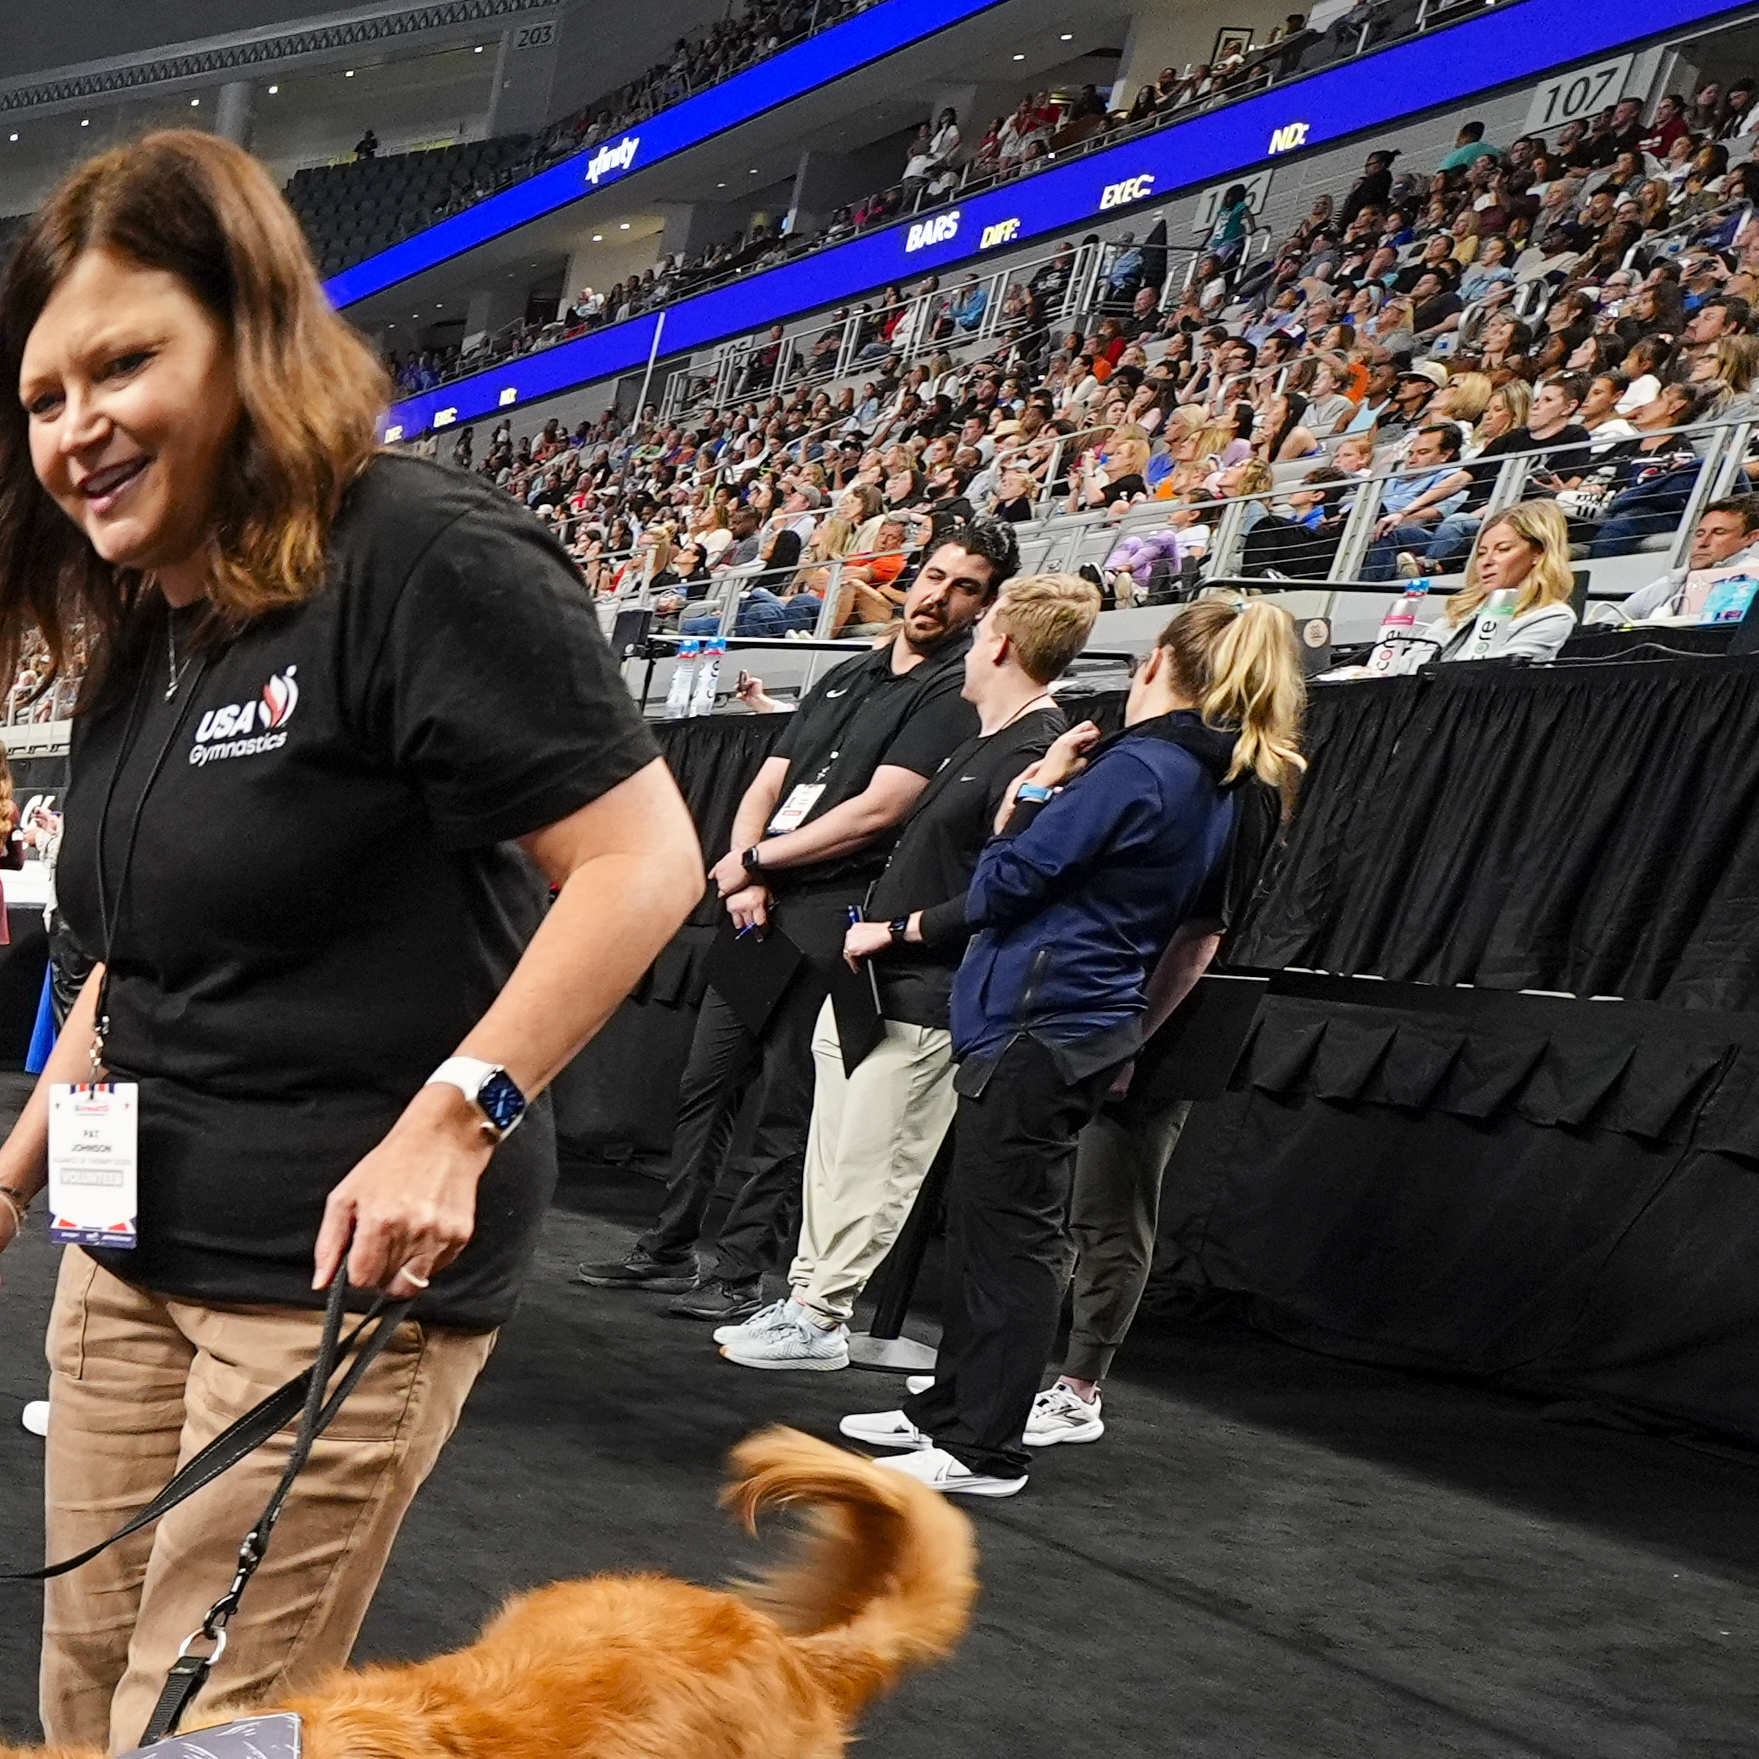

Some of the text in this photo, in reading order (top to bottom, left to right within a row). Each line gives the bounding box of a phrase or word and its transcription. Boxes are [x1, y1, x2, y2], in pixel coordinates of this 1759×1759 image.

[517, 26, 552, 48] 203
[1543, 67, 1619, 123] 107
[1269, 122, 1310, 155] ND:
[585, 137, 640, 184] xfinity
[1099, 174, 1155, 210] EXEC:
[1205, 177, 1262, 224] 16
[905, 210, 960, 253] BARS
[980, 217, 1021, 249] DIFF:
[1377, 630, 1402, 671] core
[195, 700, 257, 743] USA
[189, 731, 288, 768] Gymnastics
